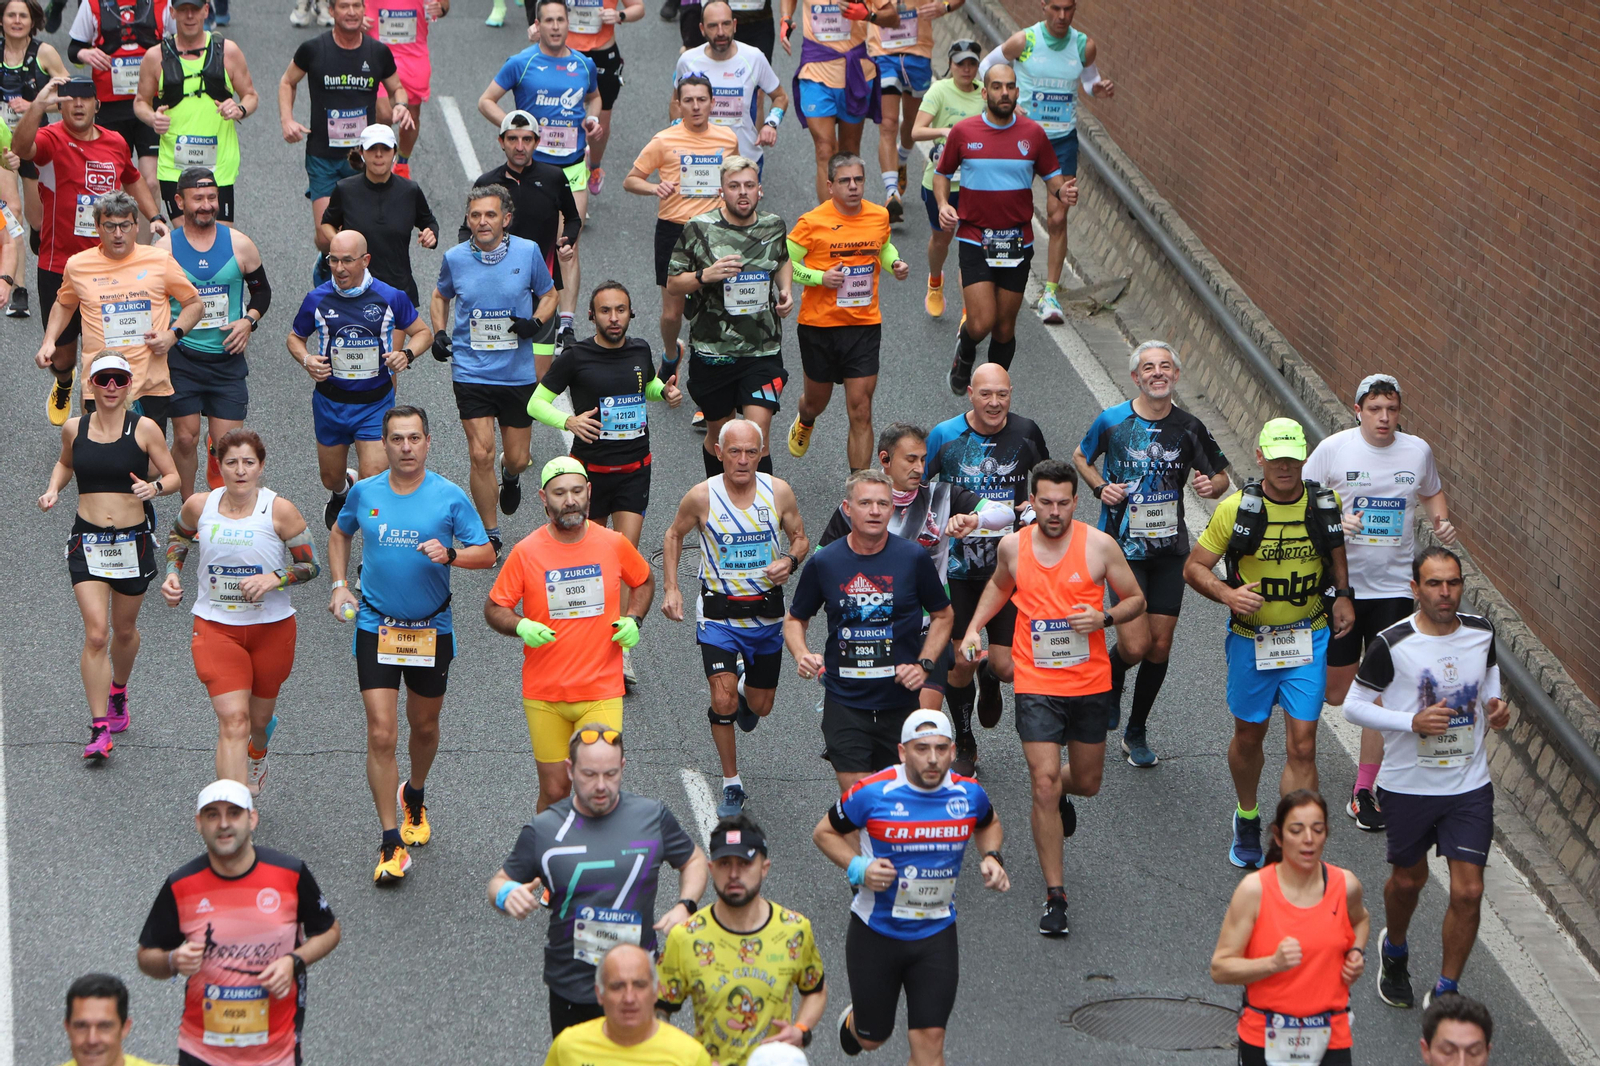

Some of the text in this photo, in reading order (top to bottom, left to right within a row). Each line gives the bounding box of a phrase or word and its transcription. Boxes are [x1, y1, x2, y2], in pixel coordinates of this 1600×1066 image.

[324, 74, 374, 88] Run2Forty2
[715, 88, 740, 96] ZURICH
[535, 95, 560, 106] Run
[550, 119, 574, 127] ZURICH
[190, 137, 214, 145] ZURICH
[694, 169, 710, 177] 9358
[995, 229, 1020, 238] ZURICH
[852, 266, 874, 275] ZURICH
[739, 272, 766, 281] ZURICH
[852, 280, 868, 288] 8040
[198, 285, 223, 295] ZURICH
[739, 287, 756, 296] 9042
[99, 290, 150, 302] Maratón Sevilla
[118, 302, 146, 311] ZURICH
[484, 309, 512, 318] ZURICH
[119, 317, 137, 325] 8225
[484, 324, 502, 332] 8416
[346, 338, 374, 347] ZURICH
[346, 352, 364, 360] 8630
[617, 395, 642, 405] ZURICH
[616, 411, 636, 420] 12120
[979, 490, 1009, 499] ZURICH
[1146, 493, 1174, 503] ZURICH
[1371, 499, 1401, 508] ZURICH
[1146, 508, 1164, 517] 8601
[1367, 514, 1391, 524] 12082
[1145, 520, 1167, 528] LOBATO
[222, 528, 254, 539] GFD
[389, 529, 420, 539] GFD
[1367, 527, 1389, 535] NACHO
[217, 537, 254, 547] RUNNING
[385, 537, 420, 545] RUNNING
[736, 533, 766, 543] ZURICH
[99, 548, 122, 558] 10284
[734, 549, 757, 558] 11392
[725, 559, 767, 569] NO HAY DOLOR
[226, 566, 257, 575] ZURICH
[563, 567, 596, 579] ZURICH
[565, 585, 586, 595] 9303
[1049, 622, 1069, 630] ZURI
[1274, 621, 1305, 632] ZURICH
[397, 633, 416, 642] 6161
[854, 629, 887, 638] ZURICH
[1050, 636, 1071, 645] 8598
[1271, 635, 1296, 645] 10068
[395, 646, 418, 655] TAINHA
[855, 646, 874, 656] 2934
[1051, 649, 1072, 657] Carlos
[1269, 649, 1301, 658] AIR BAEZA
[857, 659, 875, 667] BRET
[1437, 734, 1458, 744] 9726
[1433, 747, 1463, 757] Juan Luis
[884, 823, 969, 841] C.A. PUEBLA
[921, 868, 953, 878] ZURICH
[918, 885, 939, 896] 9772
[597, 909, 635, 924] ZURICH
[222, 986, 263, 999] ZURICH
[1288, 1015, 1325, 1028] ZURICH
[1287, 1035, 1312, 1047] 8337
